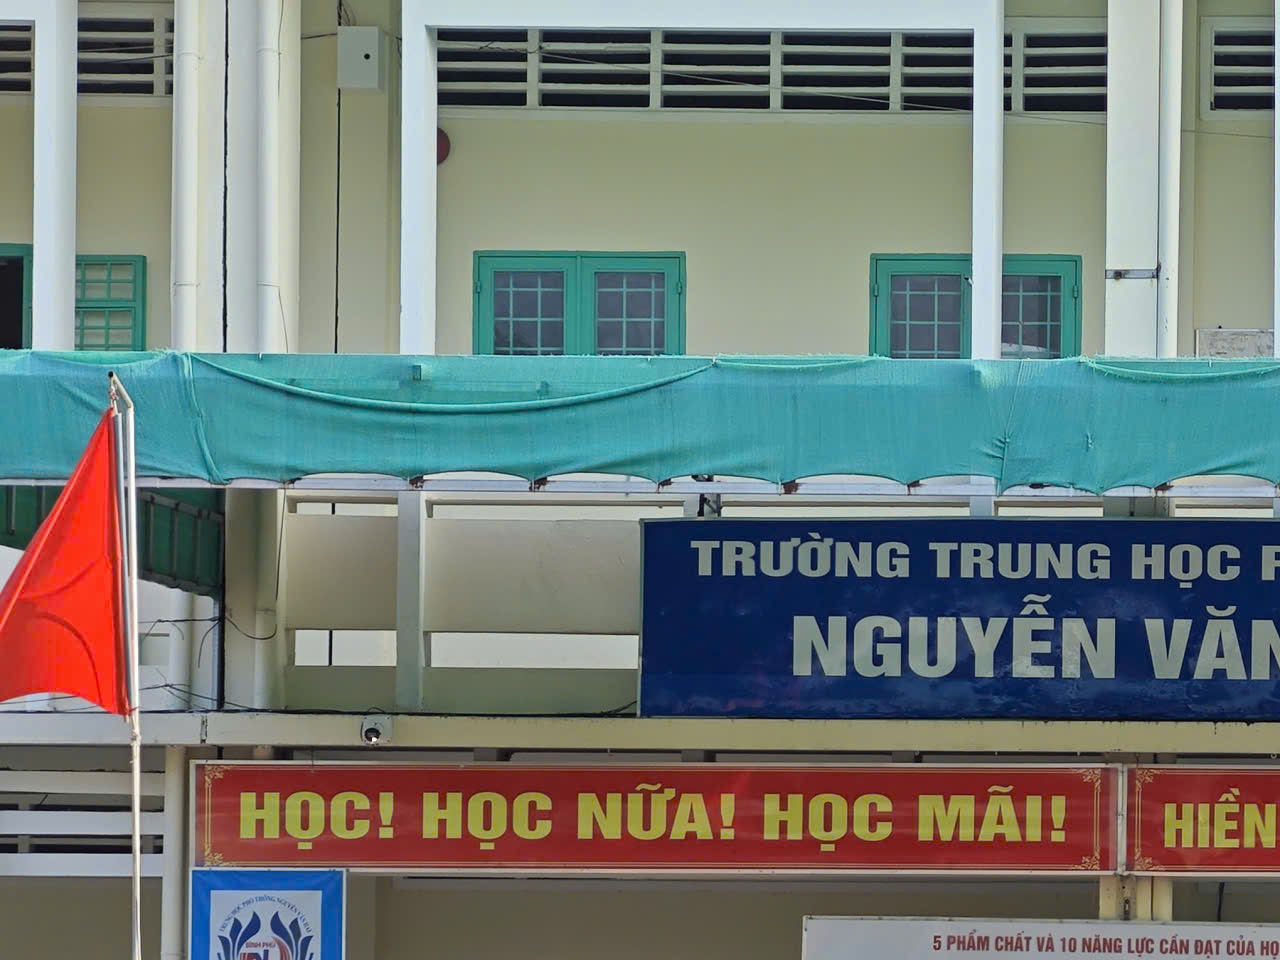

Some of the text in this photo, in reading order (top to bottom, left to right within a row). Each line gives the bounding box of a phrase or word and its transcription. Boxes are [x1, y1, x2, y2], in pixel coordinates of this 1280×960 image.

[690, 532, 911, 578] TRƯỜNG
[929, 542, 1112, 580] TRUNG
[1131, 543, 1241, 589] HỌC
[792, 593, 1116, 680] NGUYỄN
[240, 783, 1067, 852] HỌC! HỌC NỮA! HỌC MÃI!
[1163, 787, 1277, 848] HIỀN
[933, 935, 942, 951] 5
[995, 930, 1032, 952] CHẤT
[1036, 932, 1055, 953] VÀ
[1060, 937, 1077, 953] 10
[1082, 934, 1122, 954] NĂNG
[1127, 937, 1155, 957] LỰC
[1194, 939, 1222, 959] ĐẠT
[1227, 934, 1255, 957] CỦA
